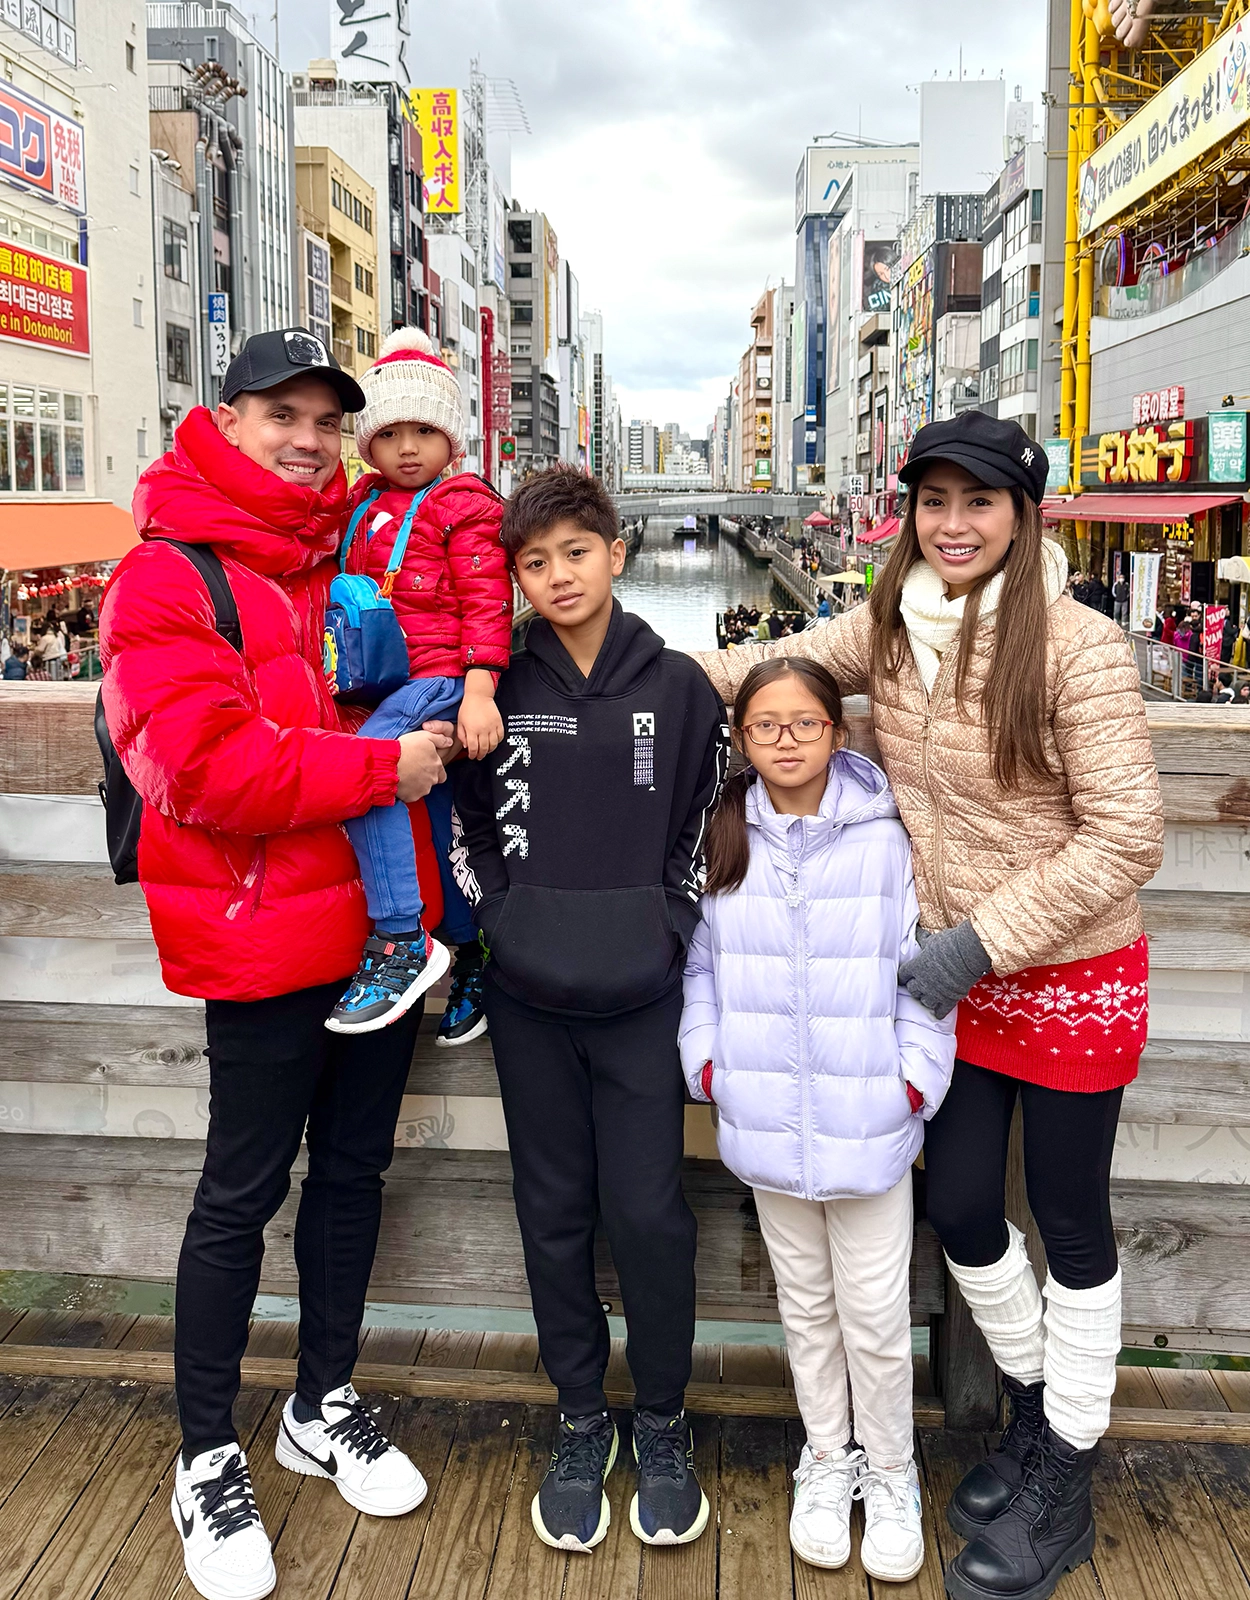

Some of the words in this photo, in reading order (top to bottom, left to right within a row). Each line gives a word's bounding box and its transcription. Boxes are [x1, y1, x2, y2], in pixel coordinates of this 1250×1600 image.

[53, 120, 81, 170] 免税
[431, 92, 454, 208] 高収入求人
[61, 165, 76, 187] TAX
[60, 182, 79, 206] FREE
[10, 312, 20, 332] in
[23, 316, 75, 344] Dotonbori.
[214, 324, 227, 373] いろりや
[1212, 421, 1242, 450] 薬
